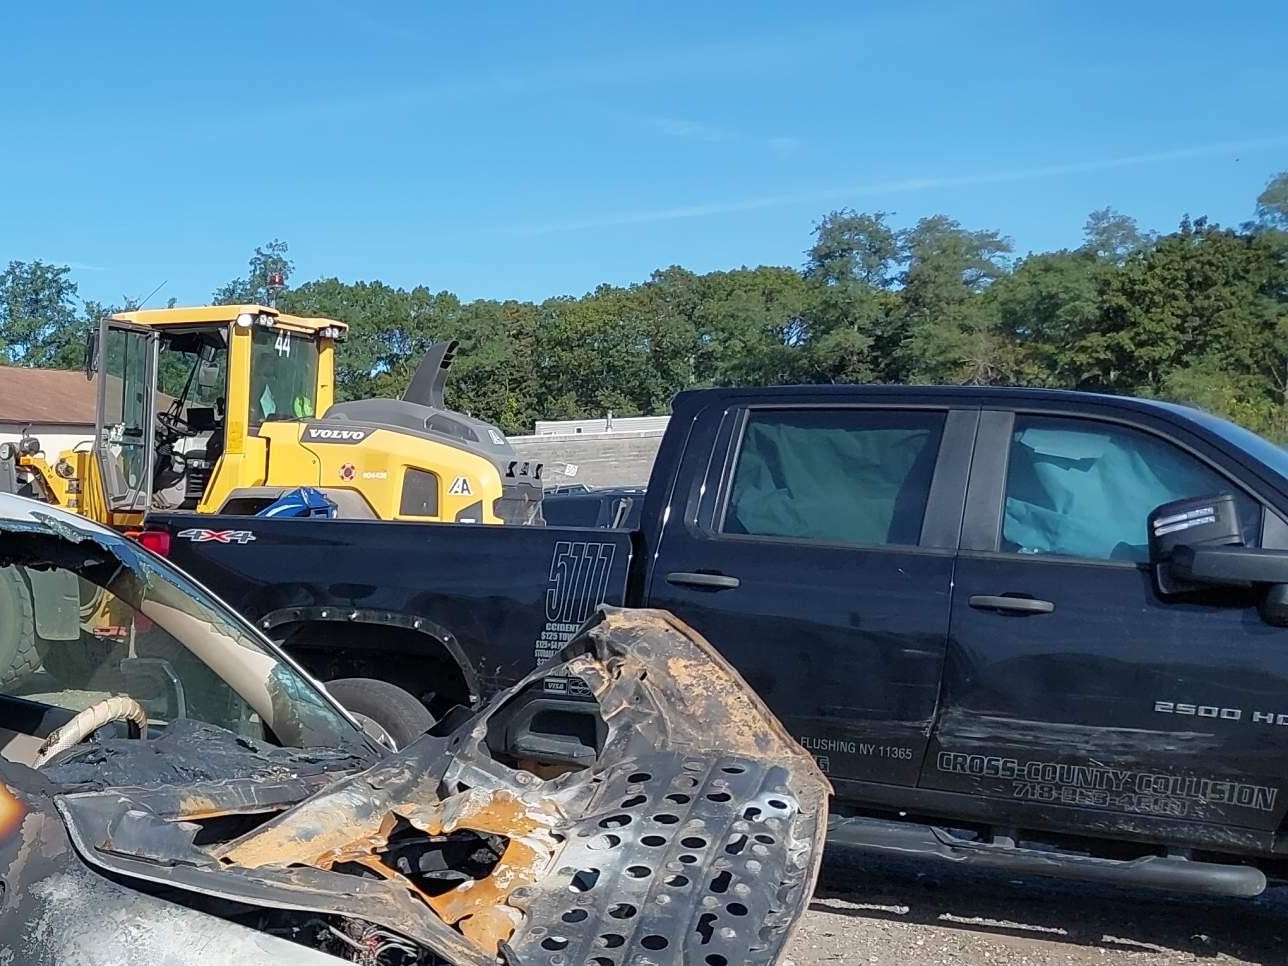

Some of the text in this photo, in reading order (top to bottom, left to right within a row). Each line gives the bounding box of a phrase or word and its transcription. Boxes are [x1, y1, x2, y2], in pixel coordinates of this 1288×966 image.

[274, 329, 291, 358] 44
[309, 428, 365, 441] VOLVO
[1155, 701, 1242, 720] 2500
[800, 736, 912, 760] FLUSHING NY 11365
[937, 751, 1279, 812] CROSS-COUNTY COLLISION
